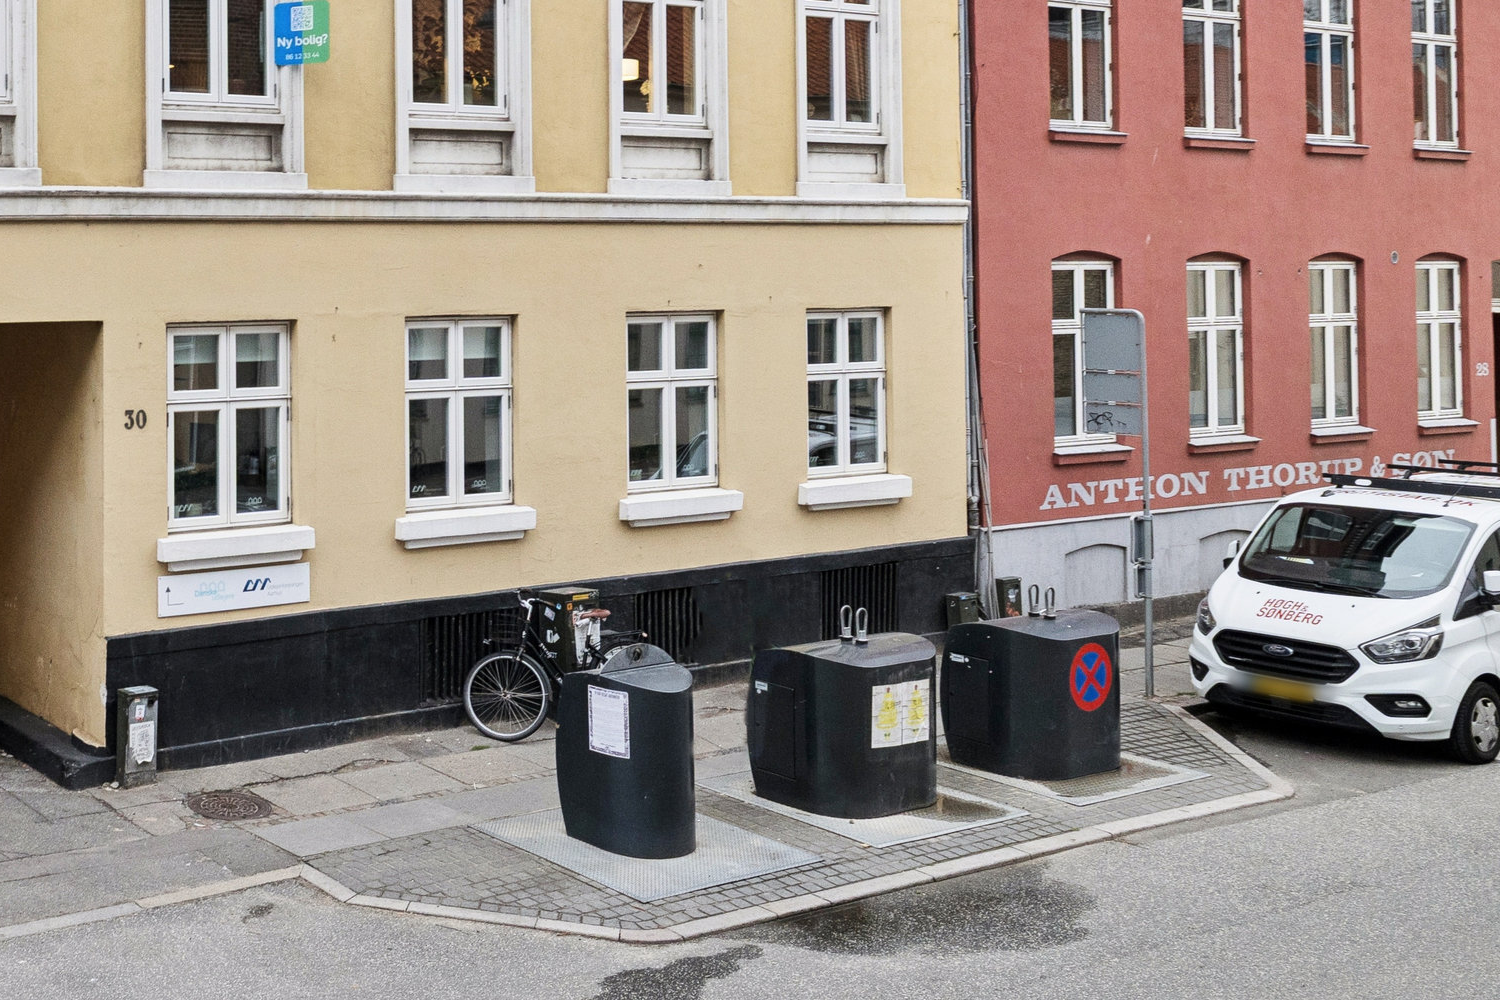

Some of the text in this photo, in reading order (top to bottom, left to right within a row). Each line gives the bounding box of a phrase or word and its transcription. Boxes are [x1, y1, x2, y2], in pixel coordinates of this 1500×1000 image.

[277, 34, 328, 49] Ny bolig?
[1476, 362, 1489, 376] 28
[124, 409, 147, 430] 30
[1039, 449, 1456, 511] ANTHON THORUP & SØN
[1264, 598, 1304, 611] HØGH
[1256, 606, 1324, 626] SØNBERG
